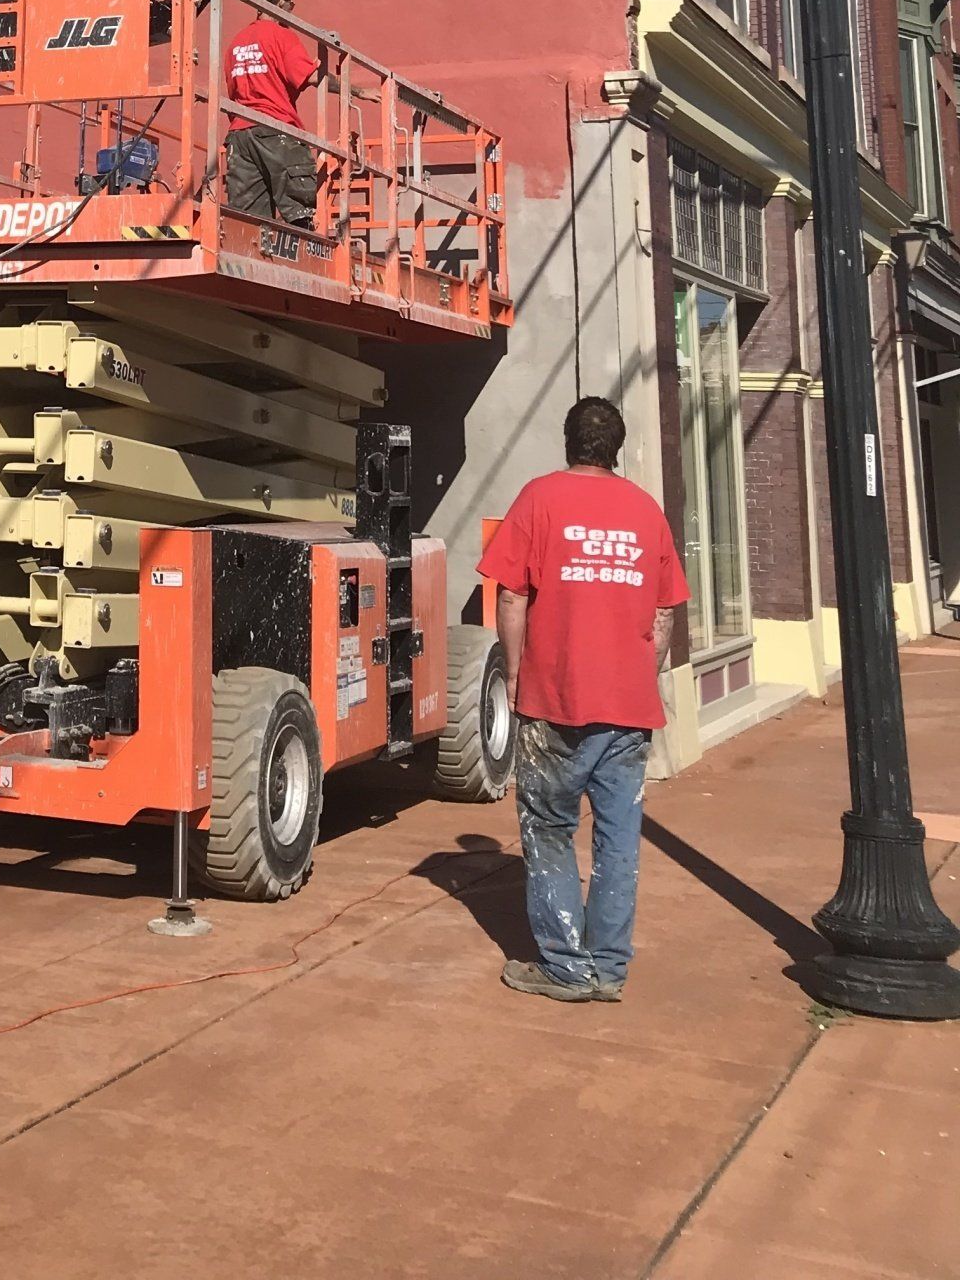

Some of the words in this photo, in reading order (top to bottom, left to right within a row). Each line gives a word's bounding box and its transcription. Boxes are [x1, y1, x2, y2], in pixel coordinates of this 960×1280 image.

[44, 15, 124, 50] JLG
[306, 238, 334, 261] 530LR
[109, 359, 146, 386] 530LRT
[563, 525, 638, 544] Gem
[582, 540, 644, 562] City
